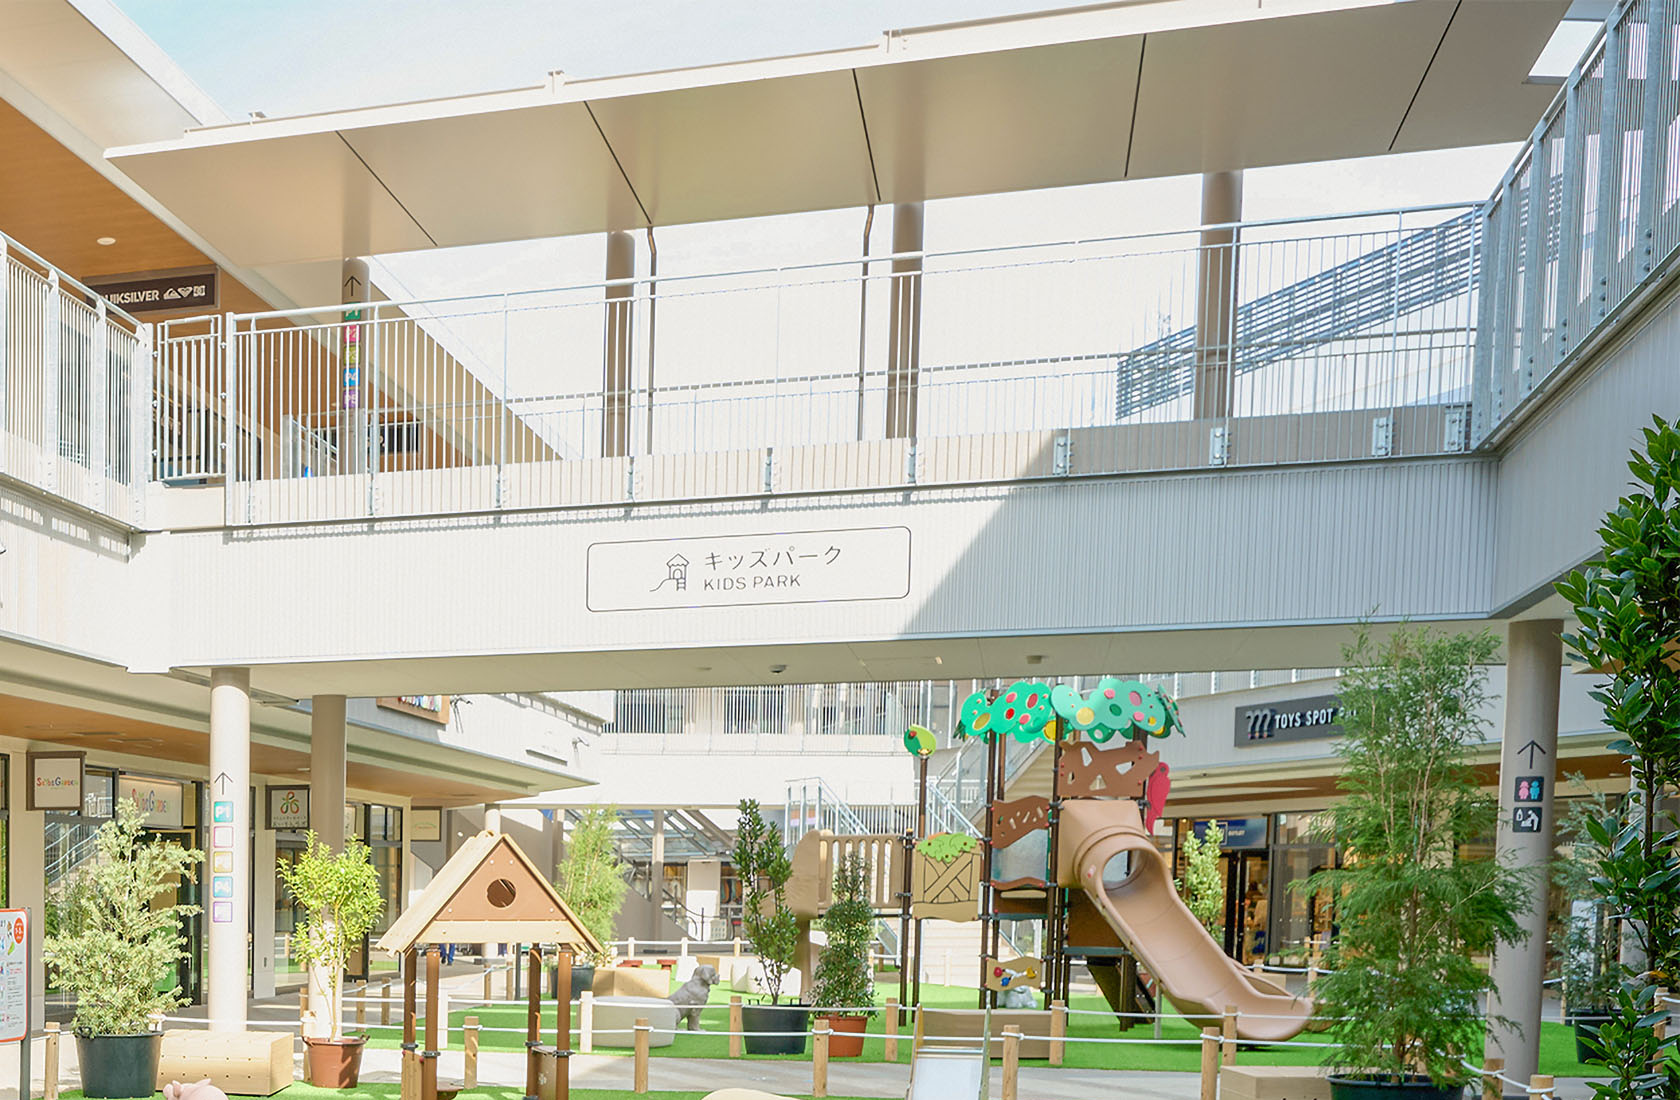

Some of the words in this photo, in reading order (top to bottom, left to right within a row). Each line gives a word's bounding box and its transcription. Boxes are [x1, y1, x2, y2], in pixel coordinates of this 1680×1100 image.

[102, 289, 160, 305] UIKSILVER
[704, 545, 841, 571] キッズパーク
[703, 577, 747, 591] KIDS
[753, 574, 801, 589] PARK
[1274, 712, 1301, 729] TOYS
[1305, 708, 1334, 726] SPOT
[215, 805, 231, 819] P1
